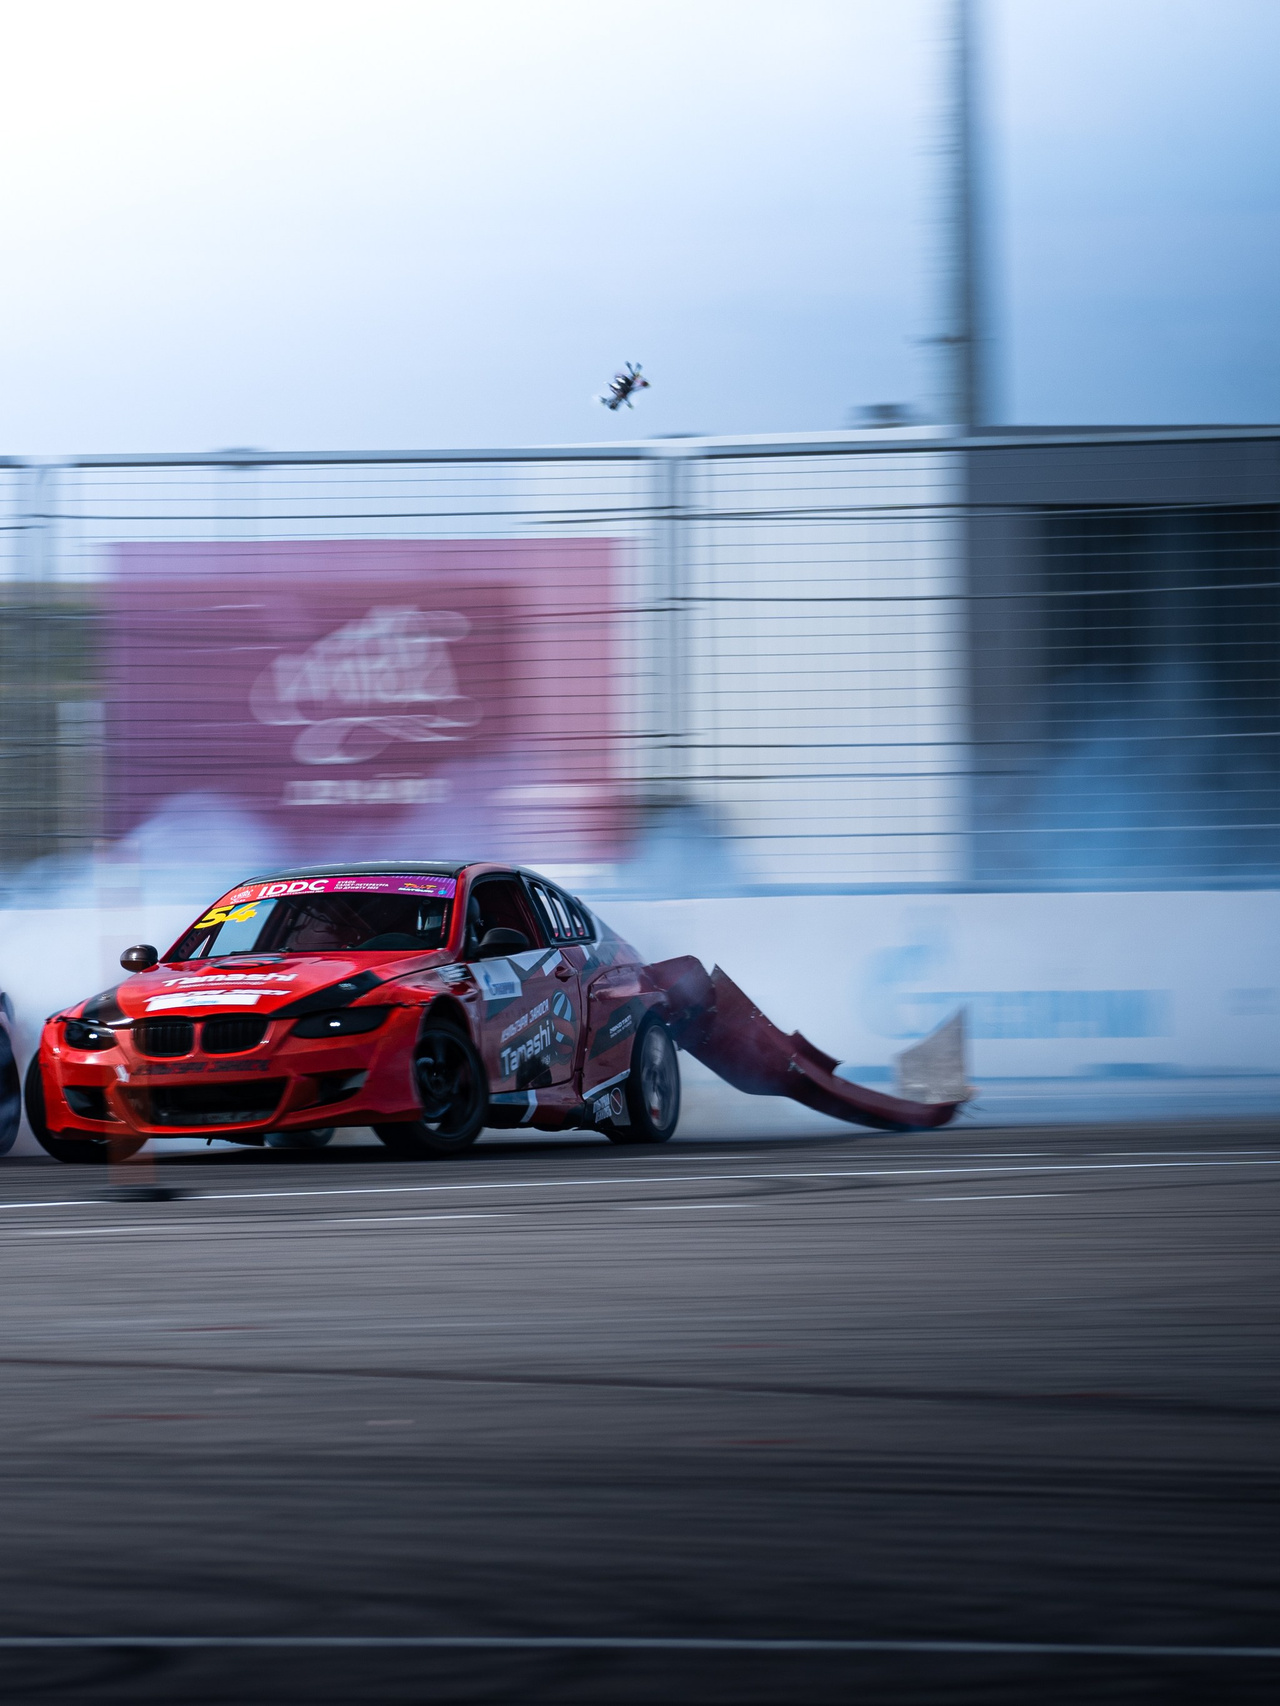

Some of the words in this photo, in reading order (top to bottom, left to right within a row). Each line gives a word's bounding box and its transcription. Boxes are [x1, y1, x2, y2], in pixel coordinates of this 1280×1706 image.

[257, 879, 329, 898] IDDC
[194, 902, 261, 929] 54
[162, 973, 299, 987] Tamashi
[501, 1019, 551, 1075] Tamashi
